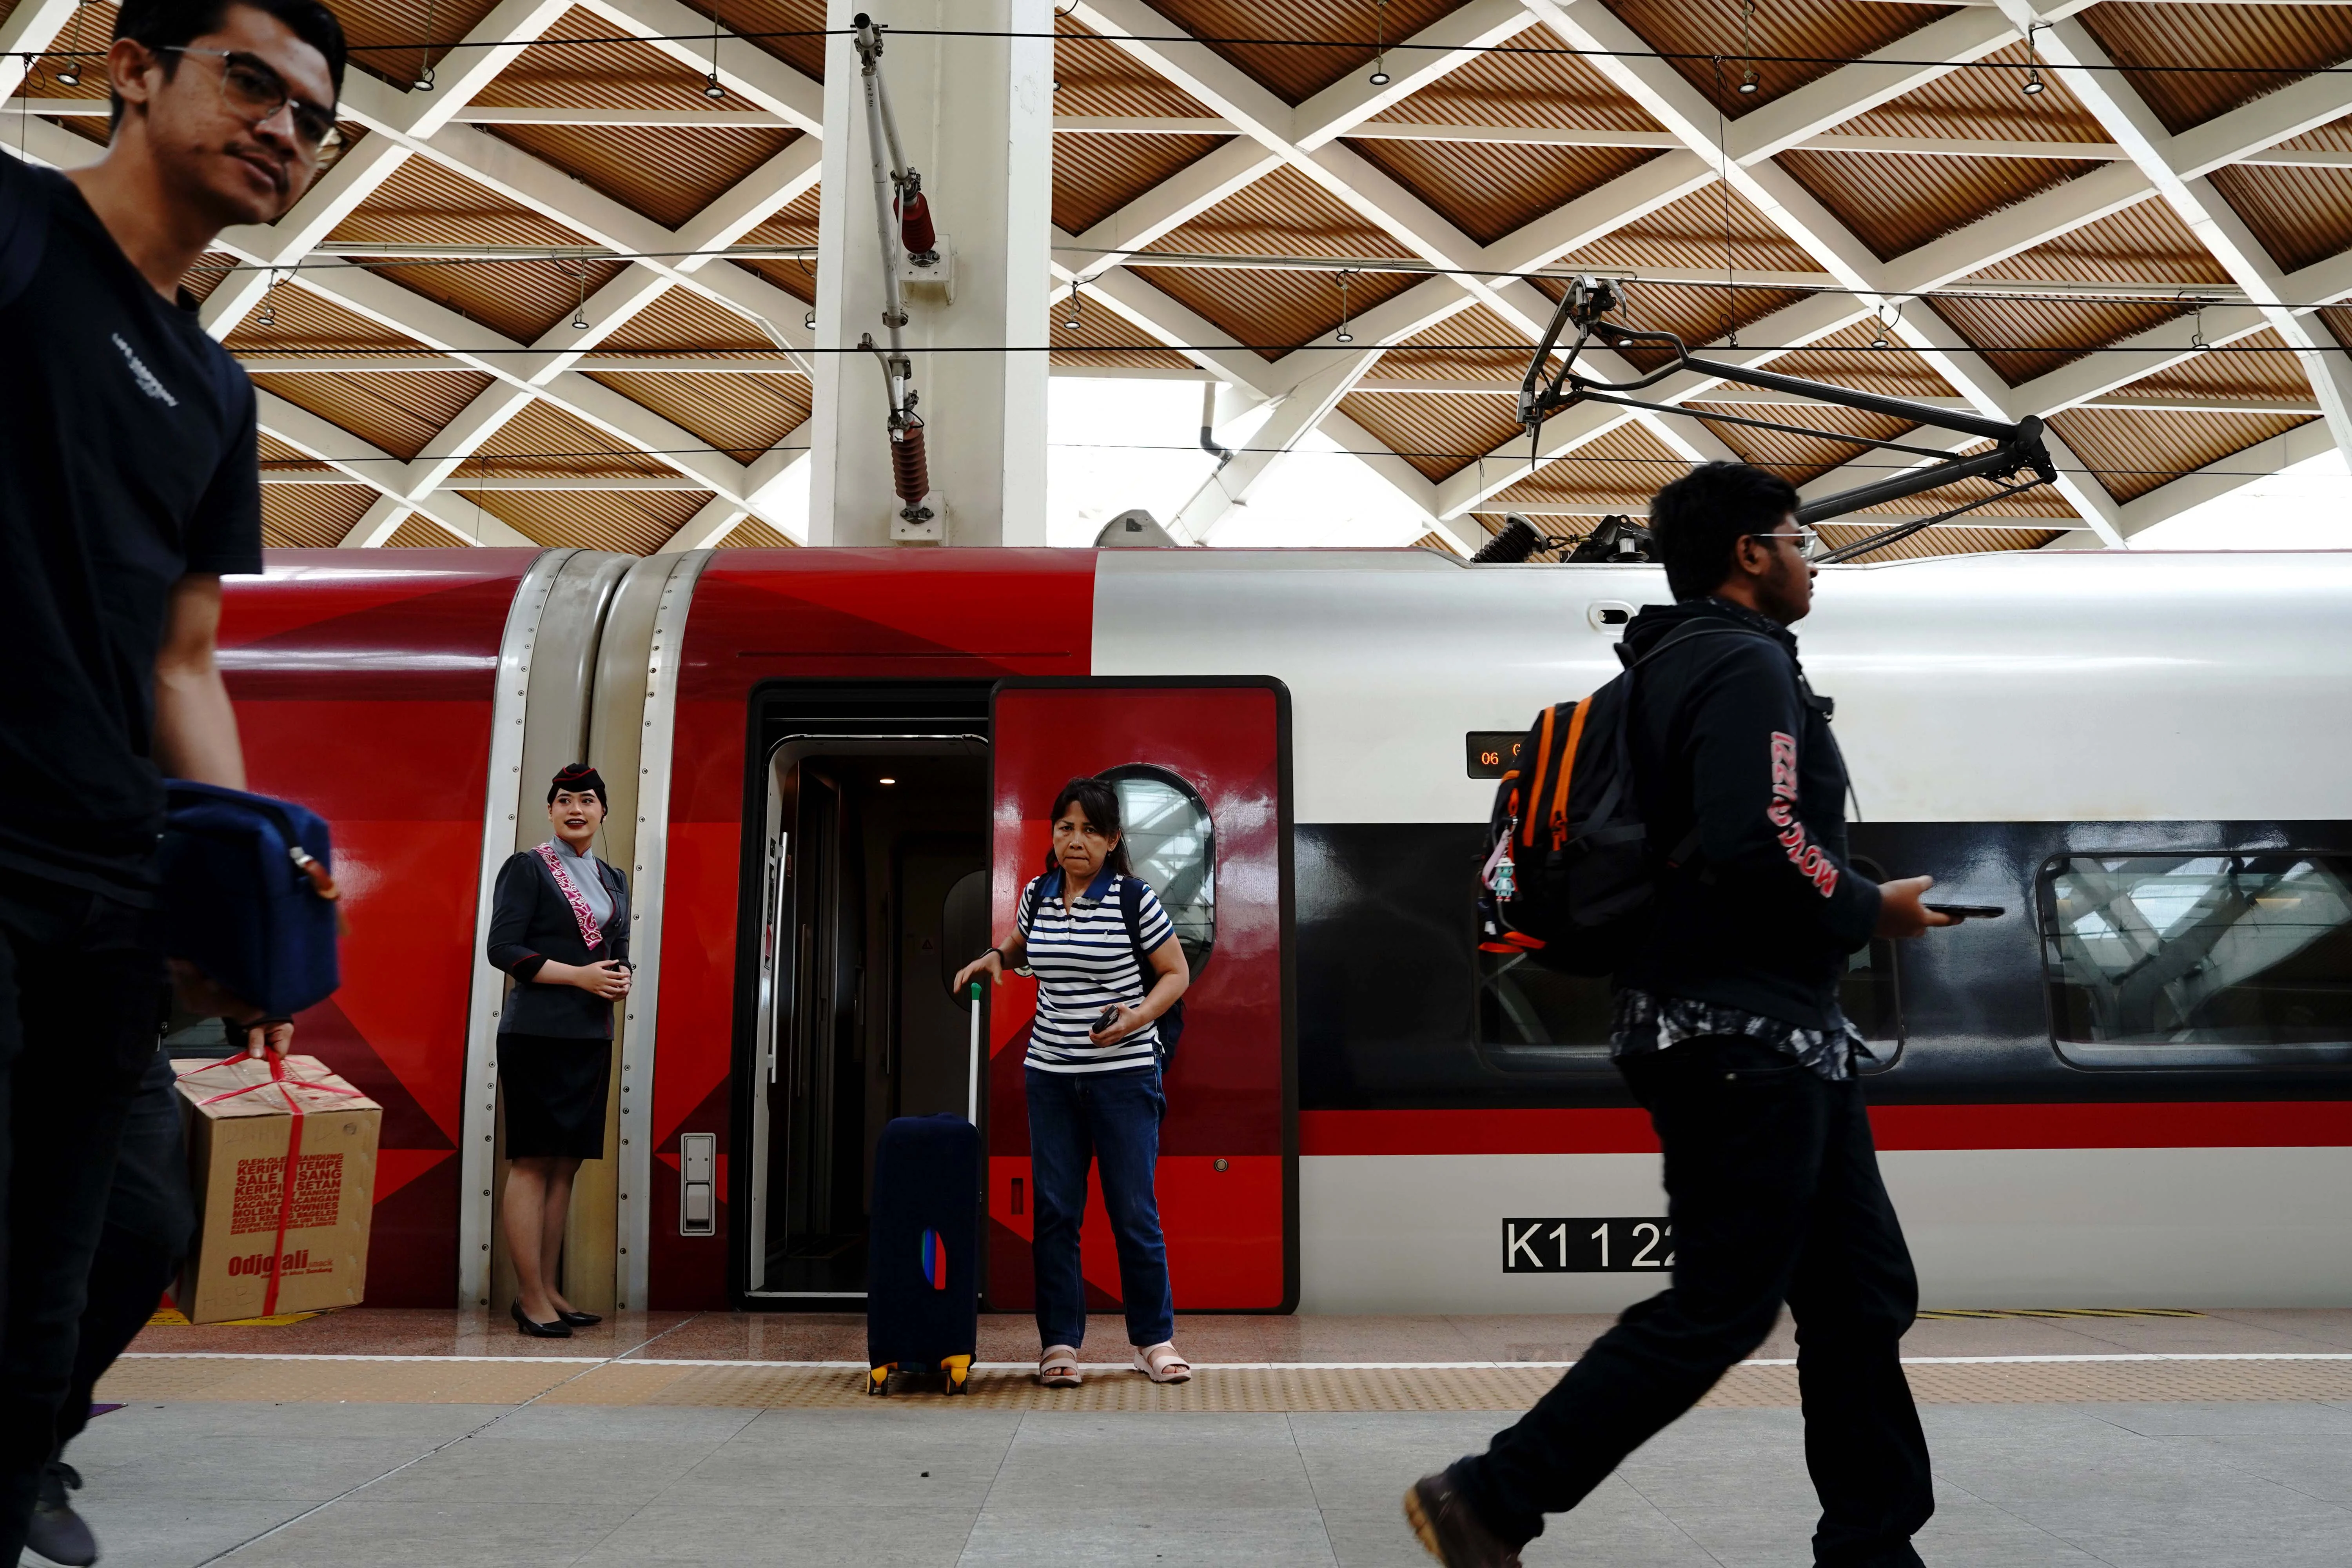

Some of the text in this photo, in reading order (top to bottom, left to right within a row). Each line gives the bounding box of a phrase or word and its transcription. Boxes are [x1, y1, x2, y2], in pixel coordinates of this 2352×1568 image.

[1481, 752, 1499, 765] 06
[238, 1156, 289, 1166] OLEH-OLE
[297, 1160, 343, 1171] TEMPE
[236, 1173, 278, 1186] SALE
[296, 1180, 341, 1191] SETAN
[234, 1195, 339, 1210] KACANG-ACANGAN
[232, 1207, 274, 1218] MOLEN
[232, 1216, 256, 1225] SOES
[228, 1249, 309, 1276] Odjoali
